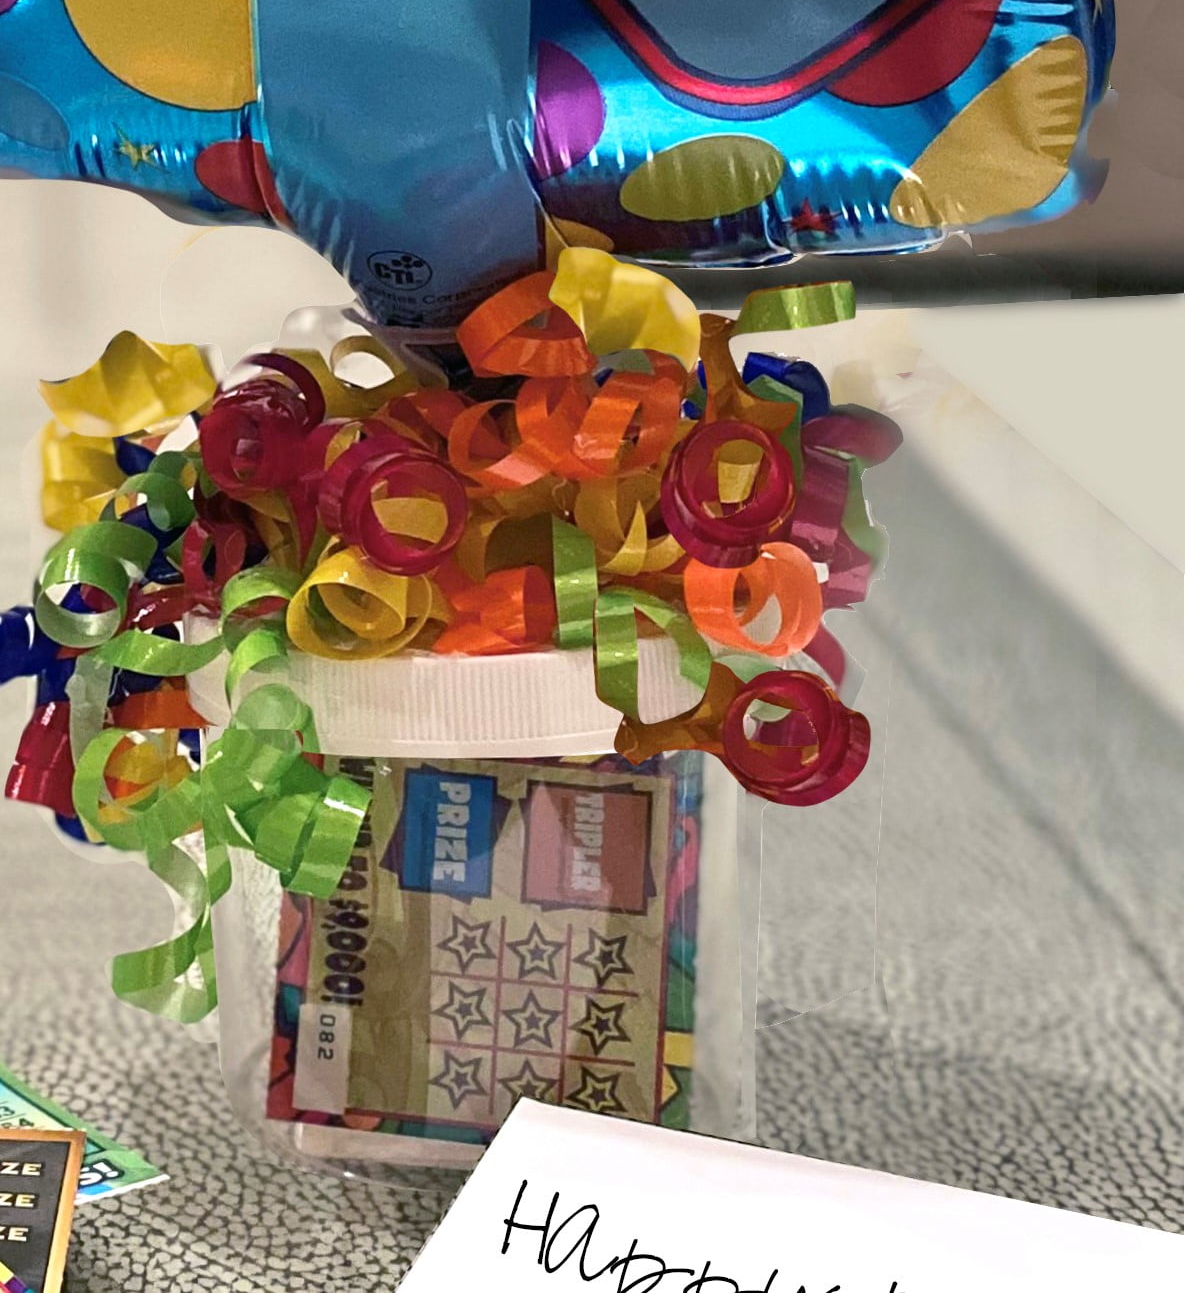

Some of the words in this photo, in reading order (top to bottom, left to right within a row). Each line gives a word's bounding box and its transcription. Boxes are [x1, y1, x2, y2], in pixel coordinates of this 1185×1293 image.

[433, 781, 473, 884] PRIZE
[572, 793, 605, 892] TRIPLER
[317, 1013, 336, 1060] 082
